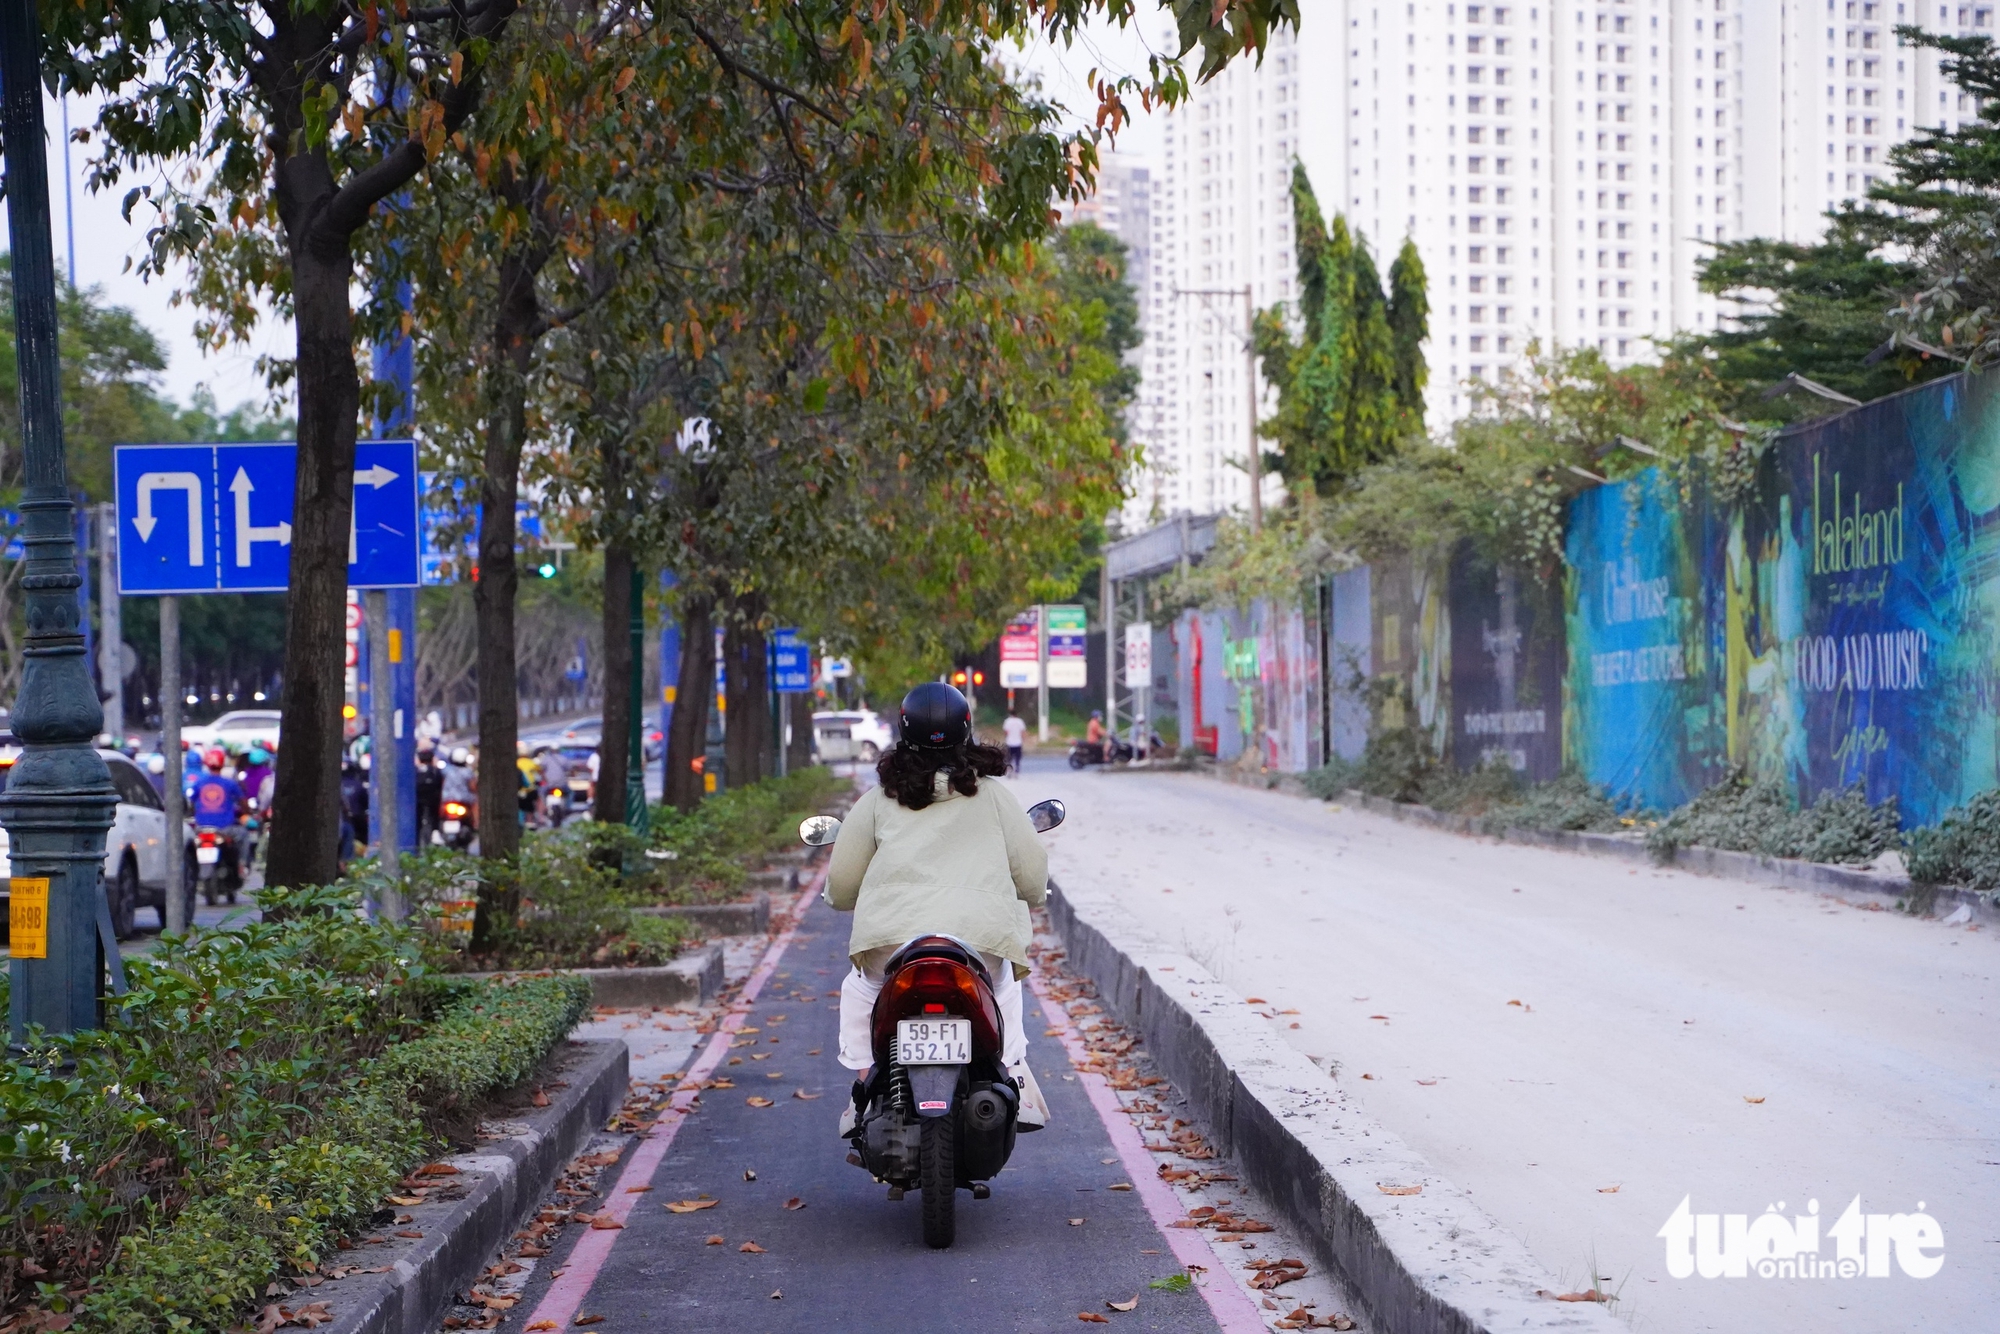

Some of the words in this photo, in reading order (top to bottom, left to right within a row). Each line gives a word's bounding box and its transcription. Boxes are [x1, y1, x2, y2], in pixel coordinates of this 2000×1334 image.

[1813, 451, 1903, 575] lalaland
[1794, 635, 1837, 692] FOOD
[909, 1023, 958, 1041] 59-F1
[902, 1043, 967, 1061] 552.14
